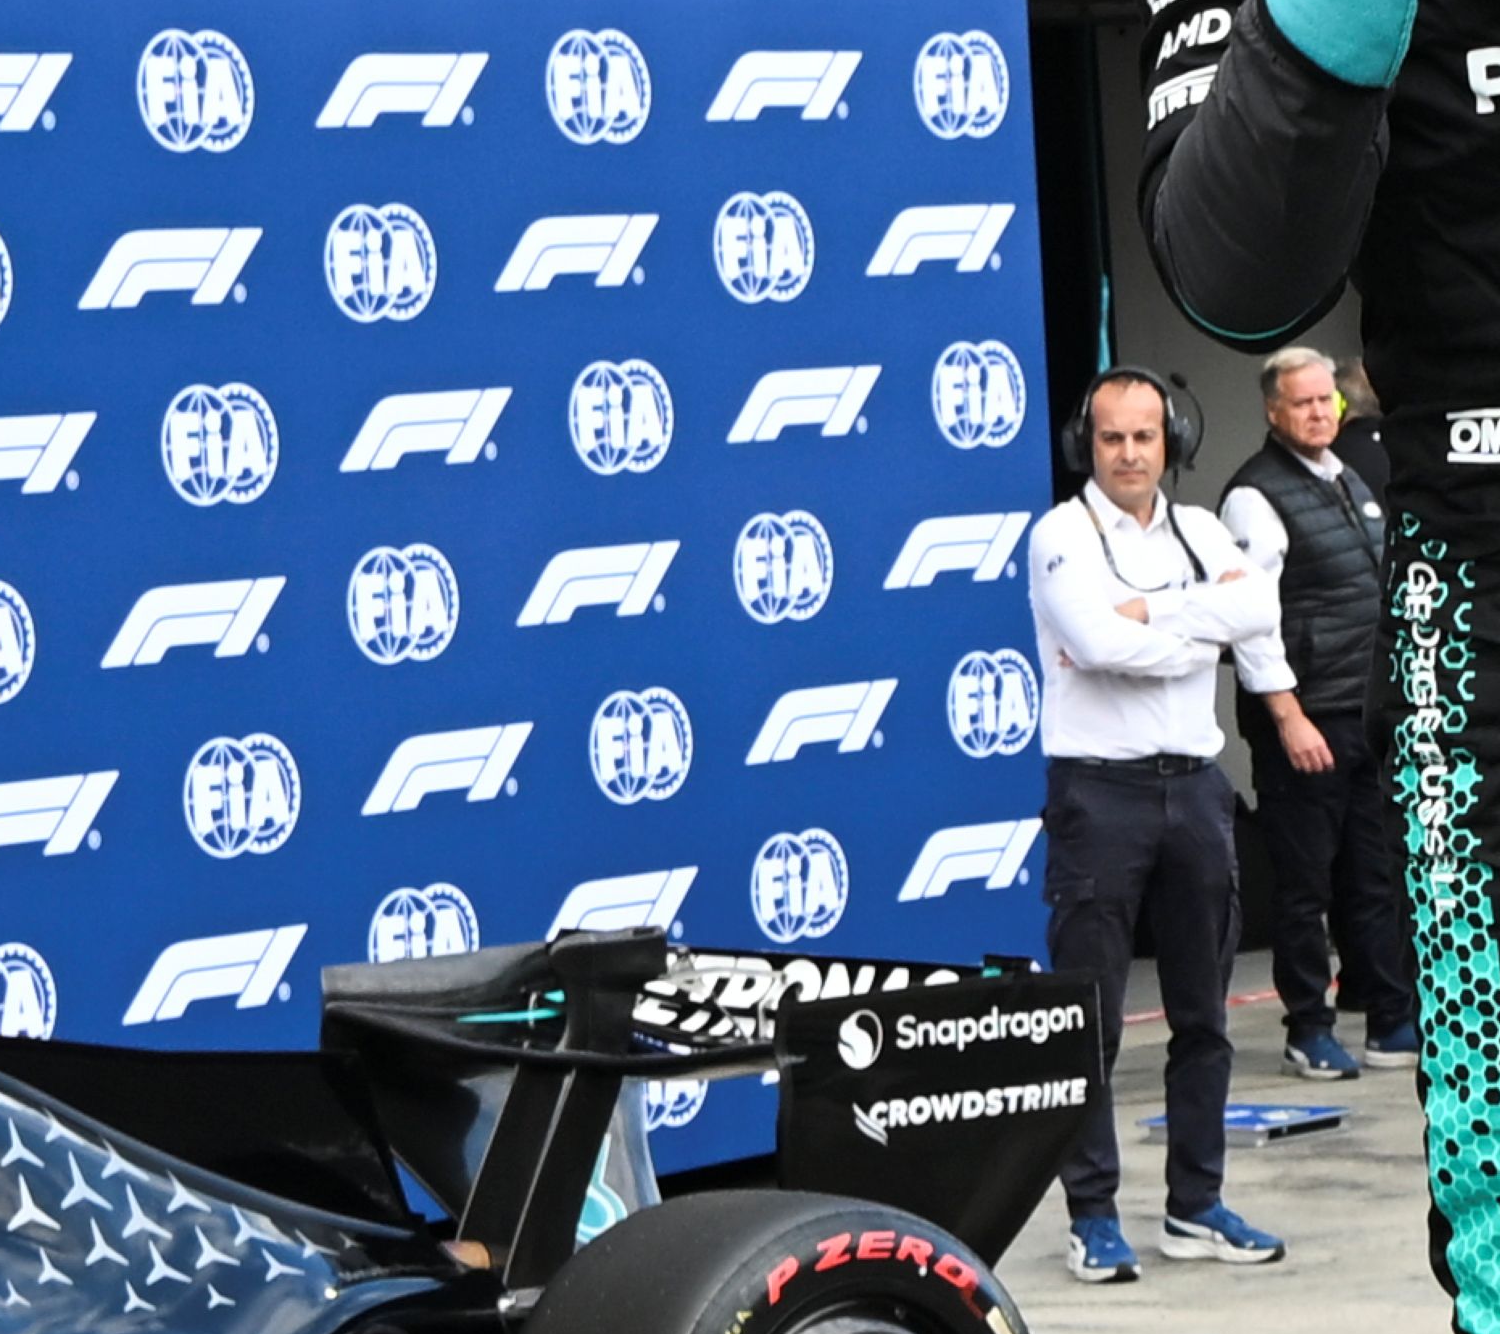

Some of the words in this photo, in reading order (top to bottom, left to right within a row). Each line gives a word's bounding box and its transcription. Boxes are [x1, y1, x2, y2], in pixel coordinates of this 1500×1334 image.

[1155, 7, 1233, 70] AMD
[316, 53, 488, 127] F1
[706, 51, 862, 120] F1
[79, 228, 262, 309] F1
[495, 214, 659, 291] F1
[867, 204, 1015, 275] F1
[340, 388, 512, 471] F1
[727, 365, 881, 443] F1
[517, 541, 680, 626] F1
[884, 512, 1031, 589] F1
[102, 577, 286, 668] F1
[746, 679, 897, 764] F1
[362, 722, 533, 815] F1
[899, 818, 1043, 901] F1
[123, 925, 307, 1024] F1
[895, 1004, 1086, 1051] Snapdragon
[868, 1077, 1088, 1129] CROWDSTRIKE
[765, 1256, 800, 1306] P
[813, 1229, 981, 1289] ZERO
